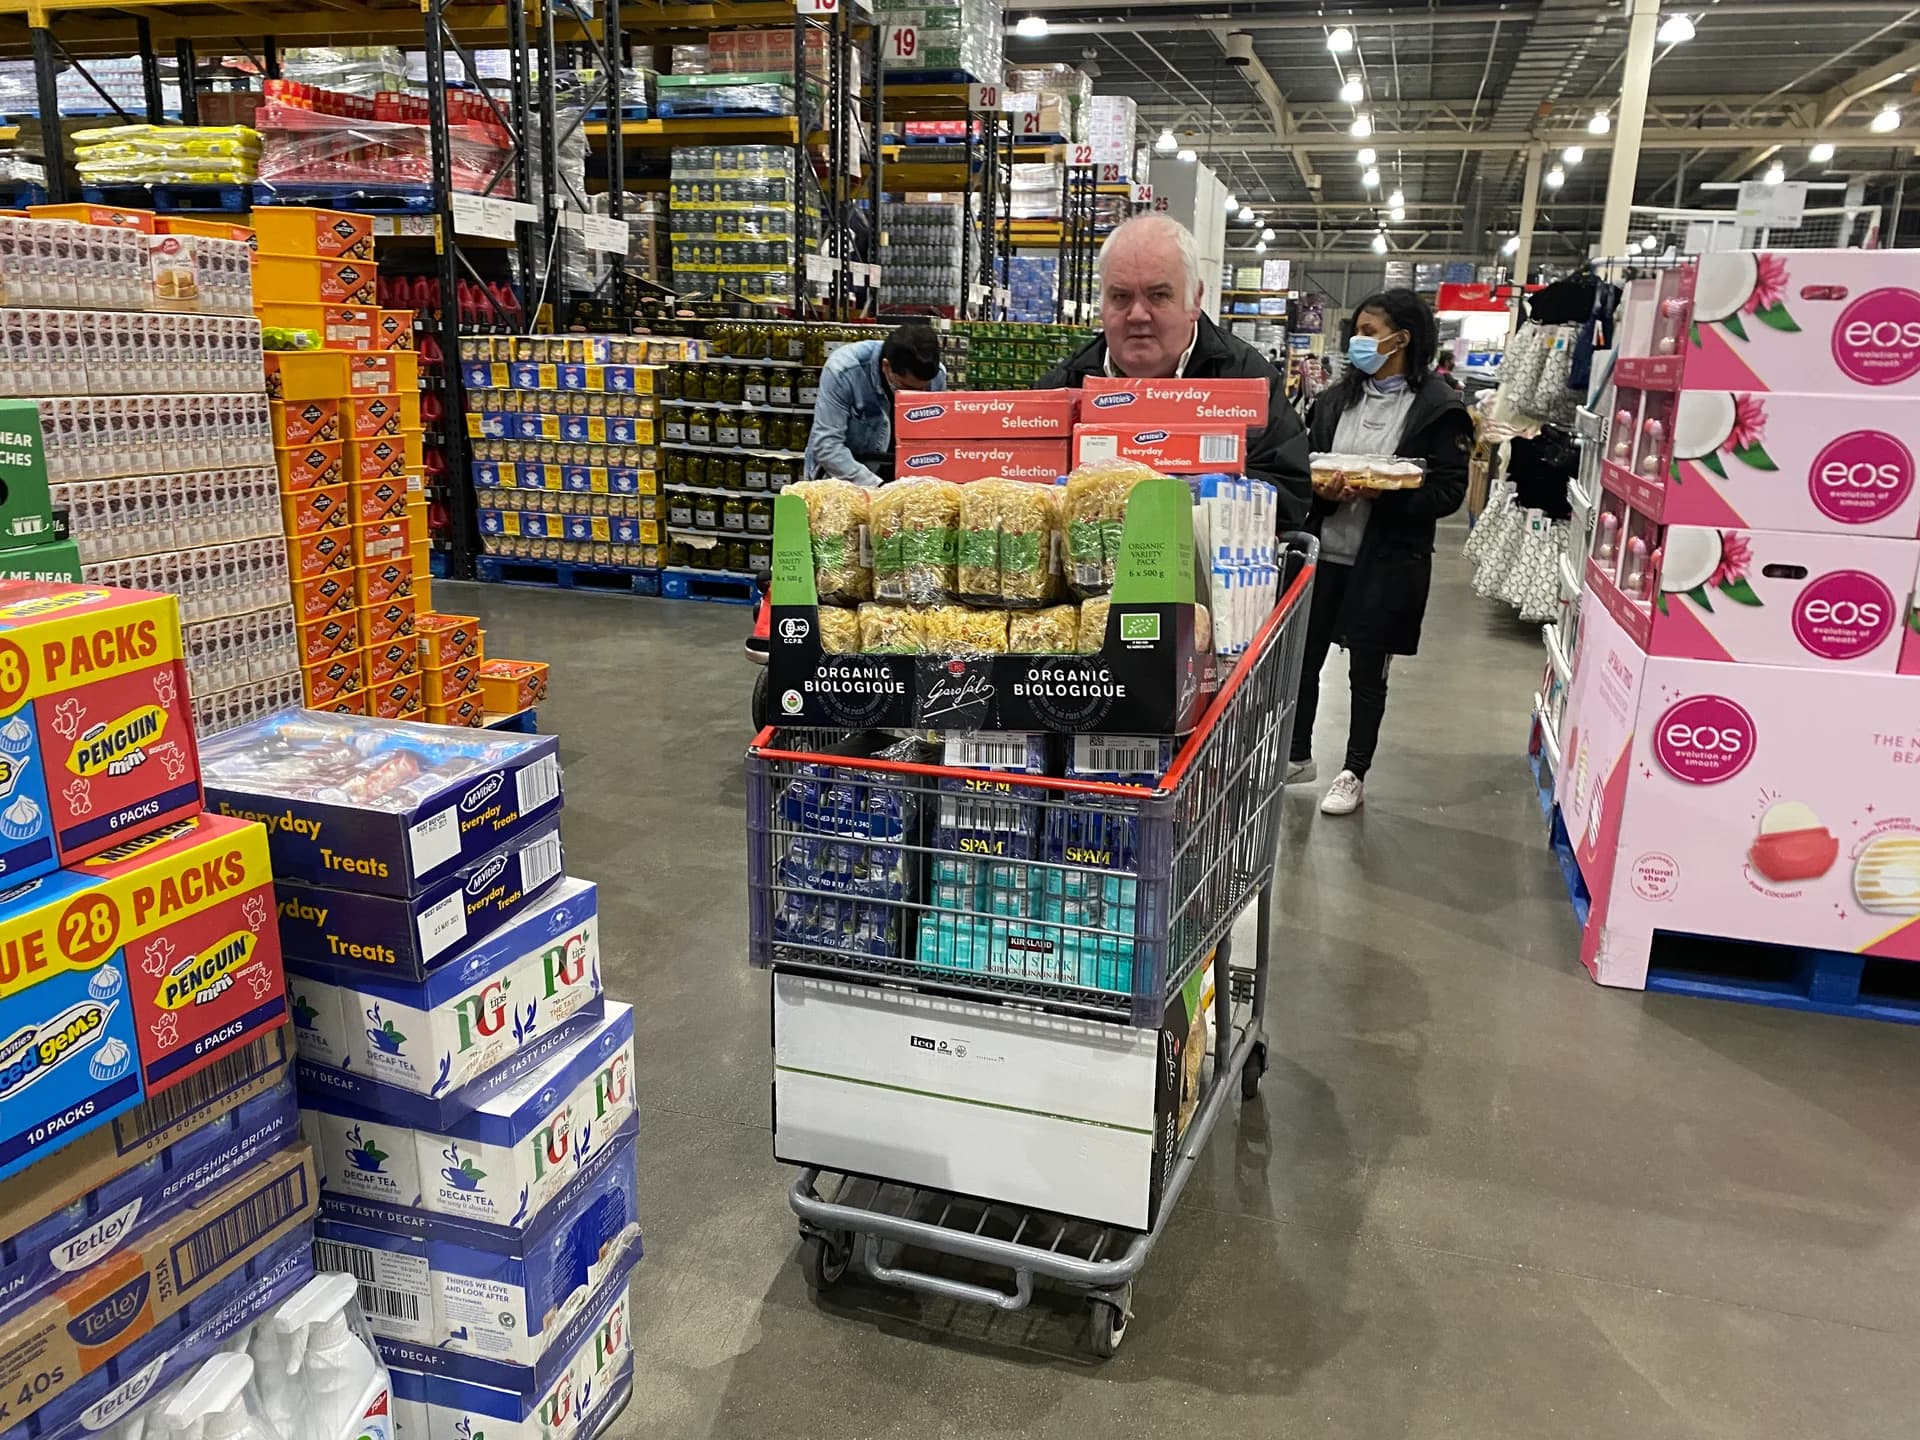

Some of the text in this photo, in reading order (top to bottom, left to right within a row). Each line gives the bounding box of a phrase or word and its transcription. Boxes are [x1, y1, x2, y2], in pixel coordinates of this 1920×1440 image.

[894, 28, 915, 56] 19
[980, 87, 995, 106] 20
[1024, 113, 1040, 133] 21
[1075, 146, 1092, 163] 22
[1104, 165, 1119, 181] 23
[1138, 186, 1151, 201] 24
[1155, 197, 1168, 210] 25
[1845, 321, 1920, 348] eos
[1146, 387, 1211, 402] Everyday
[954, 399, 1015, 414] Everyday
[1196, 405, 1257, 418] Selection
[1001, 417, 1059, 429] Selection
[954, 448, 1014, 462] Everyday
[1122, 447, 1164, 457] Everyday
[1001, 465, 1057, 477] Selection
[1153, 457, 1192, 467] Selection
[1821, 463, 1901, 488] eos
[1830, 491, 1889, 500] evolution of
[1128, 543, 1165, 551] ORGANIC
[35, 572, 72, 583] NEAR
[1142, 569, 1158, 577] 500
[1159, 571, 1164, 579] g
[1805, 600, 1882, 627] eos
[1812, 627, 1857, 636] evolution
[1822, 636, 1857, 644] smooth
[42, 620, 157, 683] PACKS
[817, 666, 891, 680] ORGANIC
[1028, 669, 1110, 682] ORGANIC
[804, 681, 905, 694] BIOLOGIQUE
[923, 674, 994, 709] Garofalo
[1013, 683, 1126, 697] BIOLOGIQUE
[77, 711, 158, 773] PENGUIN
[1667, 724, 1742, 752] eos
[1872, 733, 1904, 748] THE
[108, 747, 147, 776] mini
[1675, 750, 1732, 761] evolution of
[1685, 759, 1719, 768] smooth
[110, 801, 159, 828] 6 PACKS
[219, 802, 322, 841] Everyday
[461, 805, 502, 833] Everyday
[492, 812, 518, 831] Treats
[959, 839, 1005, 855] SPAM
[1066, 847, 1113, 865] SPAM
[320, 848, 389, 878] Treats
[1638, 867, 1673, 877] natural
[1643, 875, 1666, 883] shea
[65, 903, 112, 956] 28
[133, 851, 246, 927] PACKS
[467, 885, 505, 915] Everyday
[497, 892, 521, 911] Treats
[1764, 890, 1802, 898] COCONUT
[326, 935, 396, 964] Treats
[572, 945, 586, 958] tips
[166, 935, 246, 1007] PENGUIN
[541, 933, 586, 1001] PG
[195, 974, 234, 1006] mini
[490, 993, 507, 1008] tips
[454, 980, 507, 1054] PG
[195, 1021, 243, 1054] 6 PACKS
[311, 1035, 328, 1046] TEA
[367, 1050, 416, 1072] DECAF TEA
[488, 1030, 570, 1088] THE TASTY DECAF
[259, 1076, 266, 1085] 0
[320, 1073, 354, 1091] DECAF
[593, 1054, 625, 1122] PG
[26, 1101, 95, 1145] 10 PACKS
[531, 1110, 569, 1184] PG
[162, 1116, 283, 1198] REFRESHING BRITAIN
[194, 1148, 257, 1191] SINCE 1837
[344, 1170, 397, 1188] DECAF TEA
[557, 1145, 616, 1211] THE TASTY DECAF
[440, 1189, 495, 1207] DECAF TEA
[325, 1201, 426, 1227] THE TASTY DECAF
[62, 1210, 130, 1265] Tetley
[156, 1257, 172, 1303] 3313A
[445, 1277, 508, 1294] THINGS WE LOVE
[445, 1286, 510, 1302] AND LOOK AFTER
[79, 1285, 141, 1338] Tetley
[215, 1289, 273, 1338] SINCE 1837
[565, 1276, 620, 1344] THE TASTY DECAF
[594, 1306, 622, 1376] PG
[401, 1350, 438, 1365] DECAF
[0, 1366, 64, 1421] x 40s
[92, 1367, 157, 1425] Tetley
